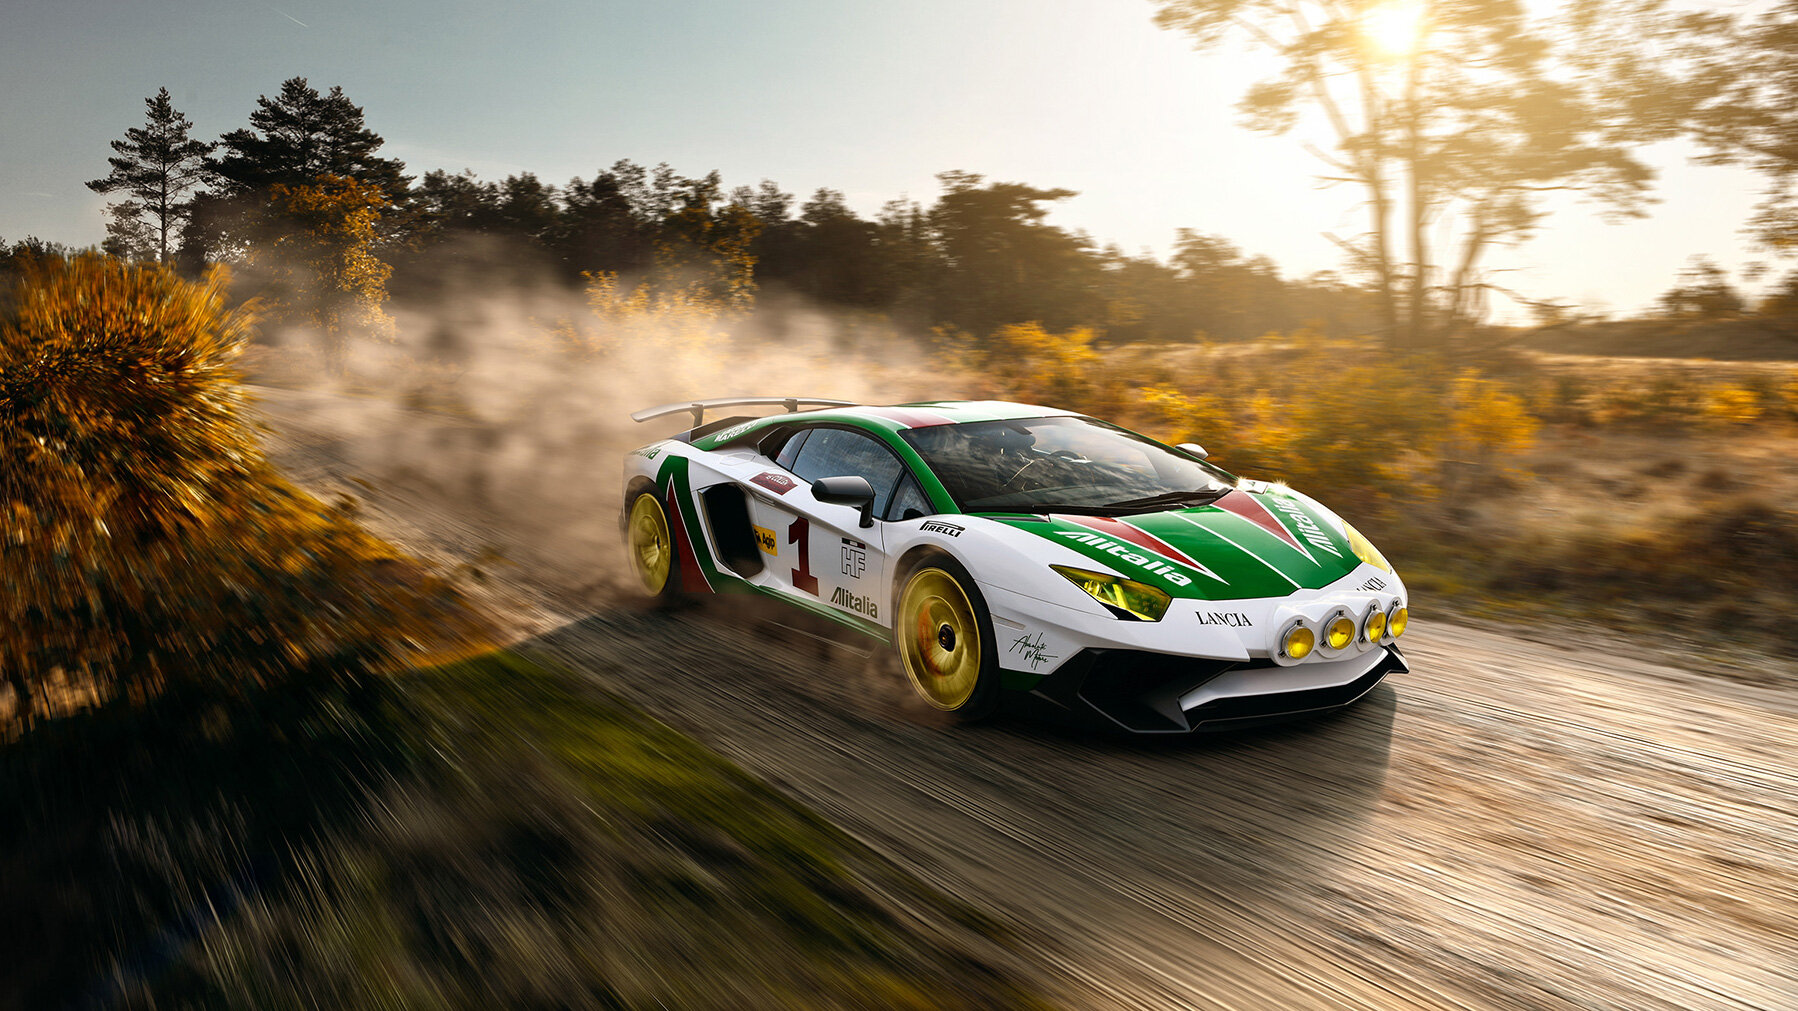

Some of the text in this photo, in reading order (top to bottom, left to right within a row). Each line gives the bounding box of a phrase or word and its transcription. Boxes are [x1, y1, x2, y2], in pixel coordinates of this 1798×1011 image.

[919, 520, 966, 538] PIRELLI
[1272, 497, 1344, 559] Alitalia
[788, 516, 819, 597] 1
[841, 546, 866, 579] HF
[1053, 531, 1193, 587] Alitalia
[1357, 576, 1387, 592] NCIA
[830, 586, 878, 619] Alitalia
[1195, 611, 1253, 628] LANCIA
